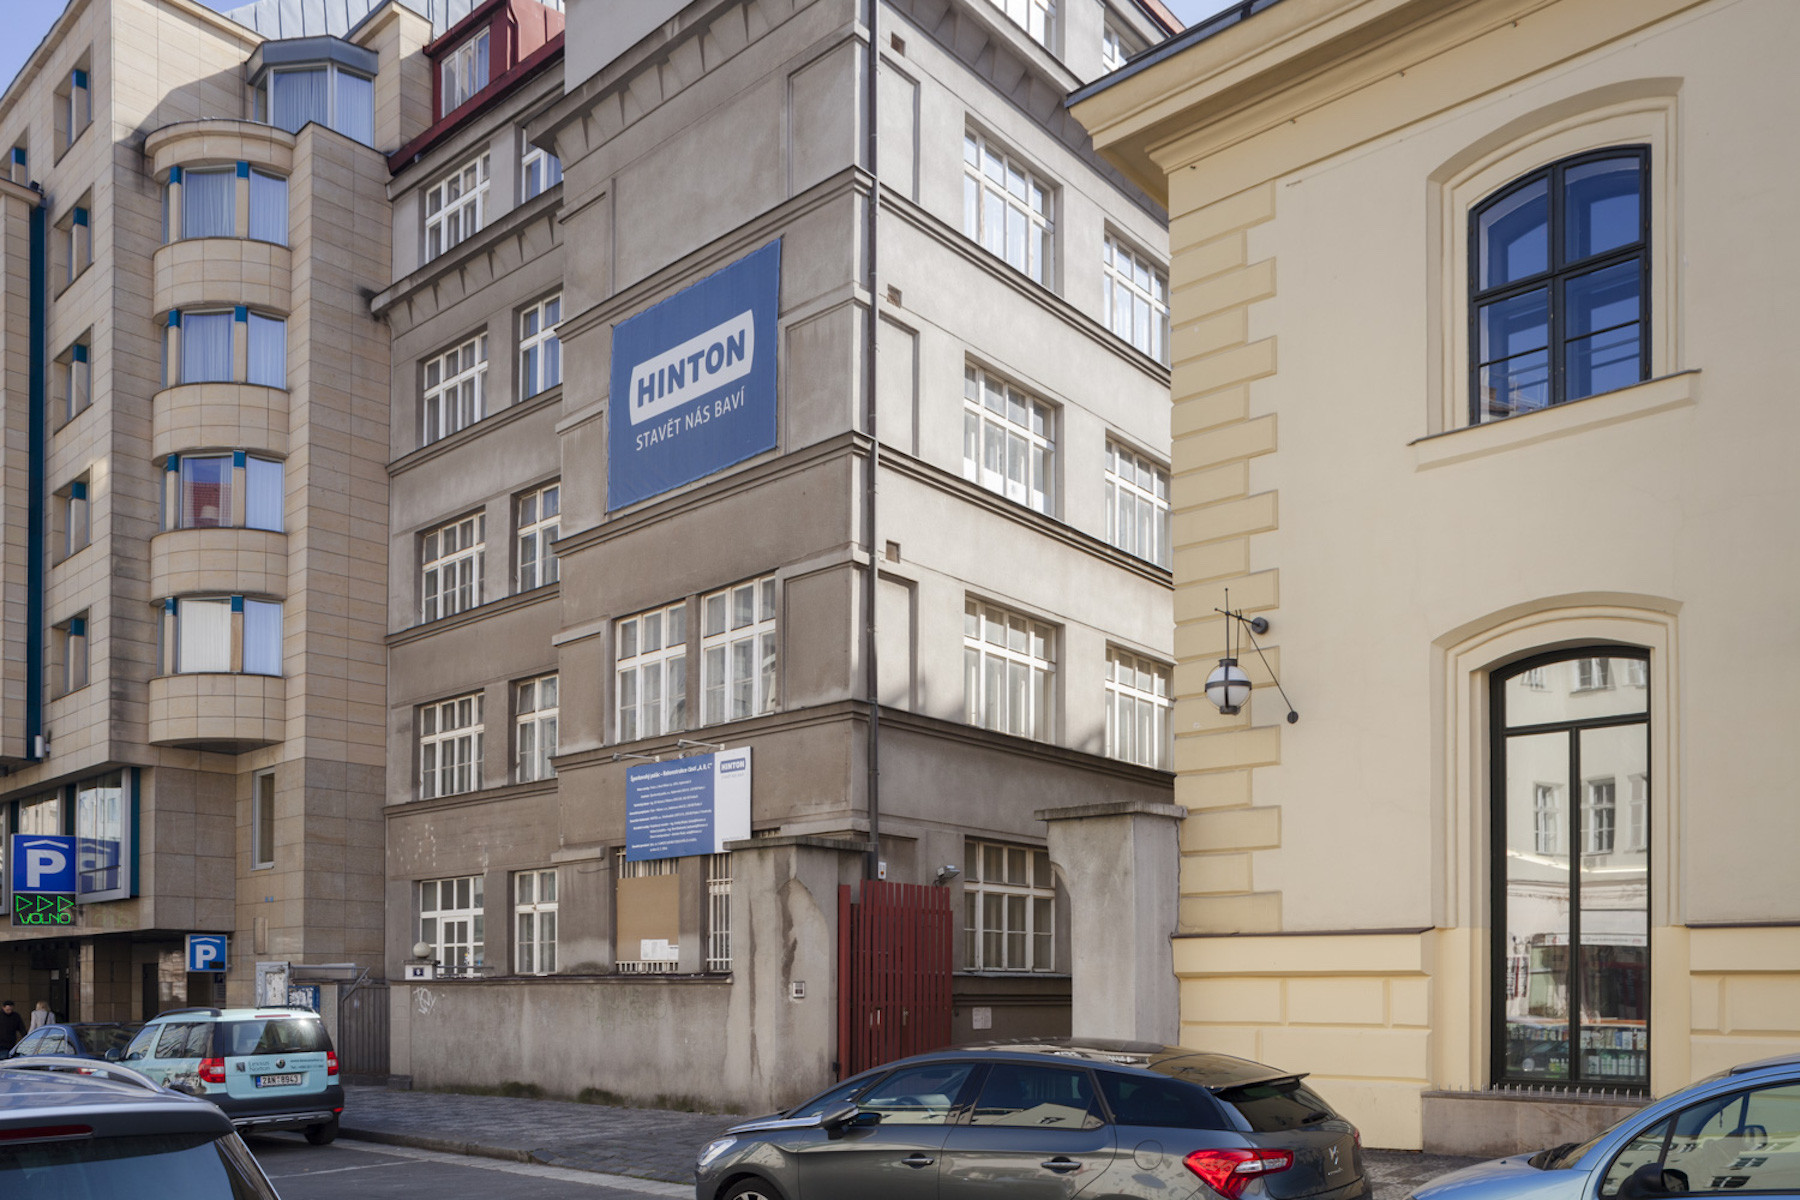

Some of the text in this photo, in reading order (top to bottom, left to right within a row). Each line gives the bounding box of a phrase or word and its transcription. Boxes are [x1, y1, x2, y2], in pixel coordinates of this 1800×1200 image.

[637, 329, 746, 409] HINTON
[636, 385, 745, 451] STAVĚT NÁS BAVÍ
[26, 849, 67, 888] P
[19, 912, 72, 925] VOLNO
[195, 944, 217, 969] P
